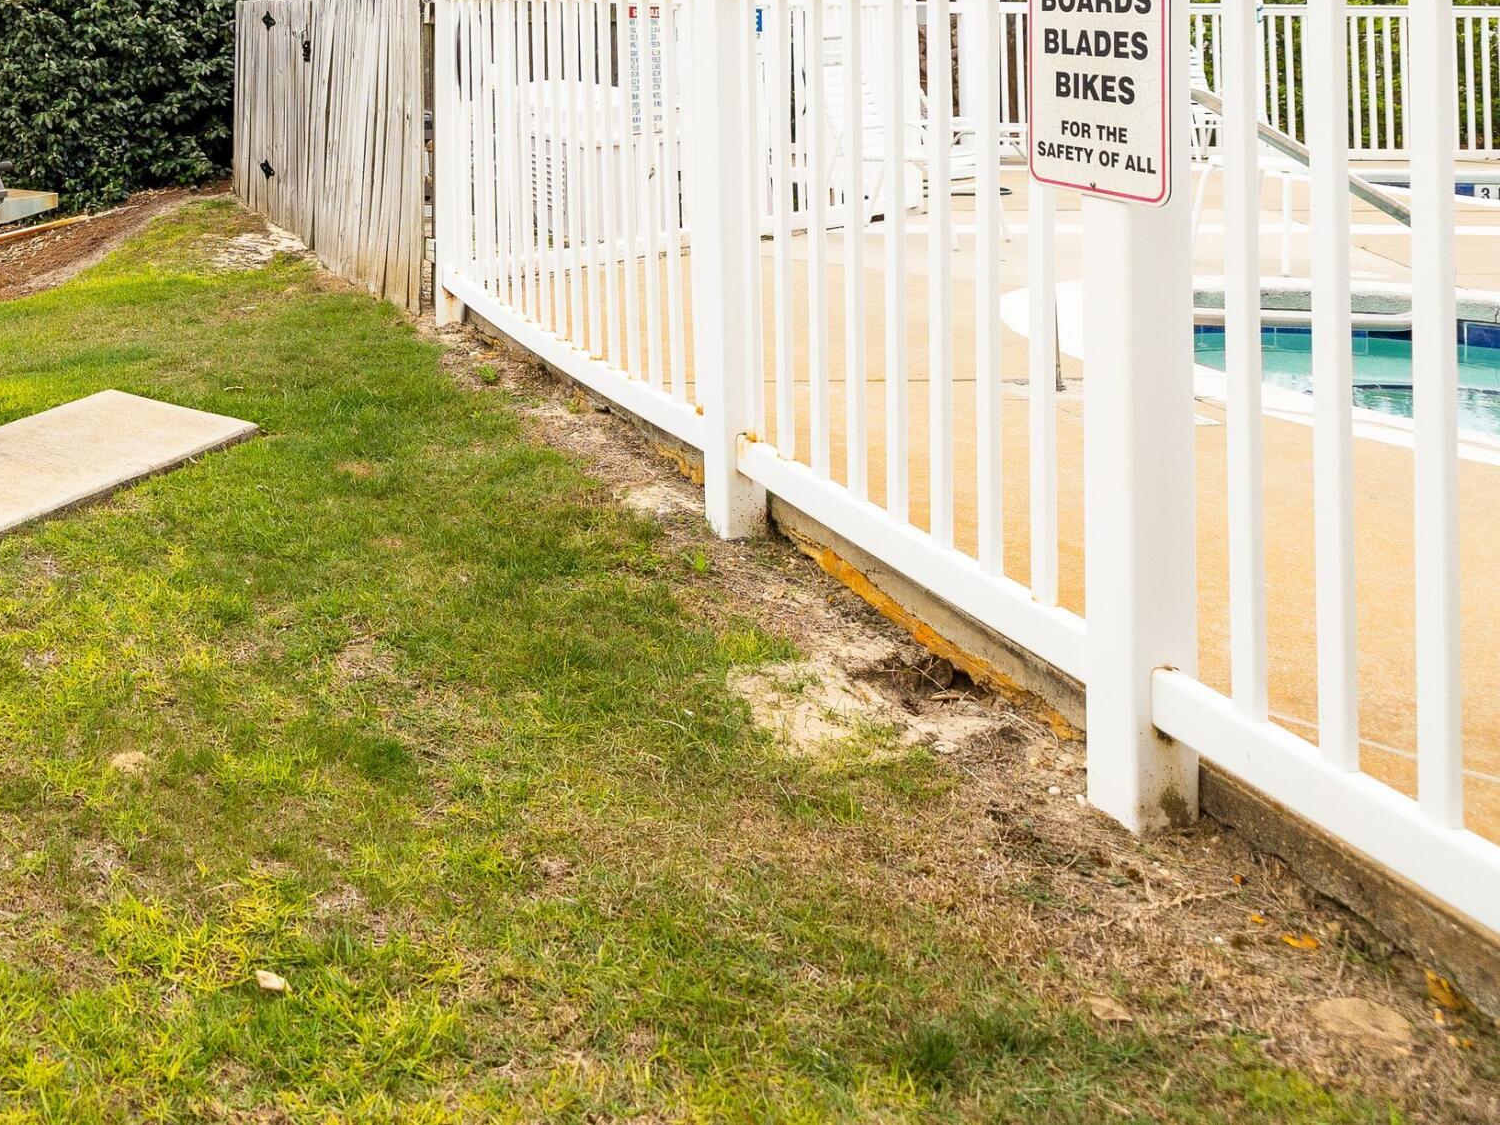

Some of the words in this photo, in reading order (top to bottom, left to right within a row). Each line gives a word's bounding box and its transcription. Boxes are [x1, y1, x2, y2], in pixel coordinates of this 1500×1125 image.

[1044, 28, 1148, 61] BLADES
[1055, 71, 1135, 105] BIKES
[1061, 120, 1091, 139] FOR
[1096, 124, 1128, 144] THE
[1037, 141, 1094, 164] SAFETY
[1099, 150, 1119, 168] OF
[1125, 154, 1156, 175] ALL
[1481, 187, 1490, 200] 3
